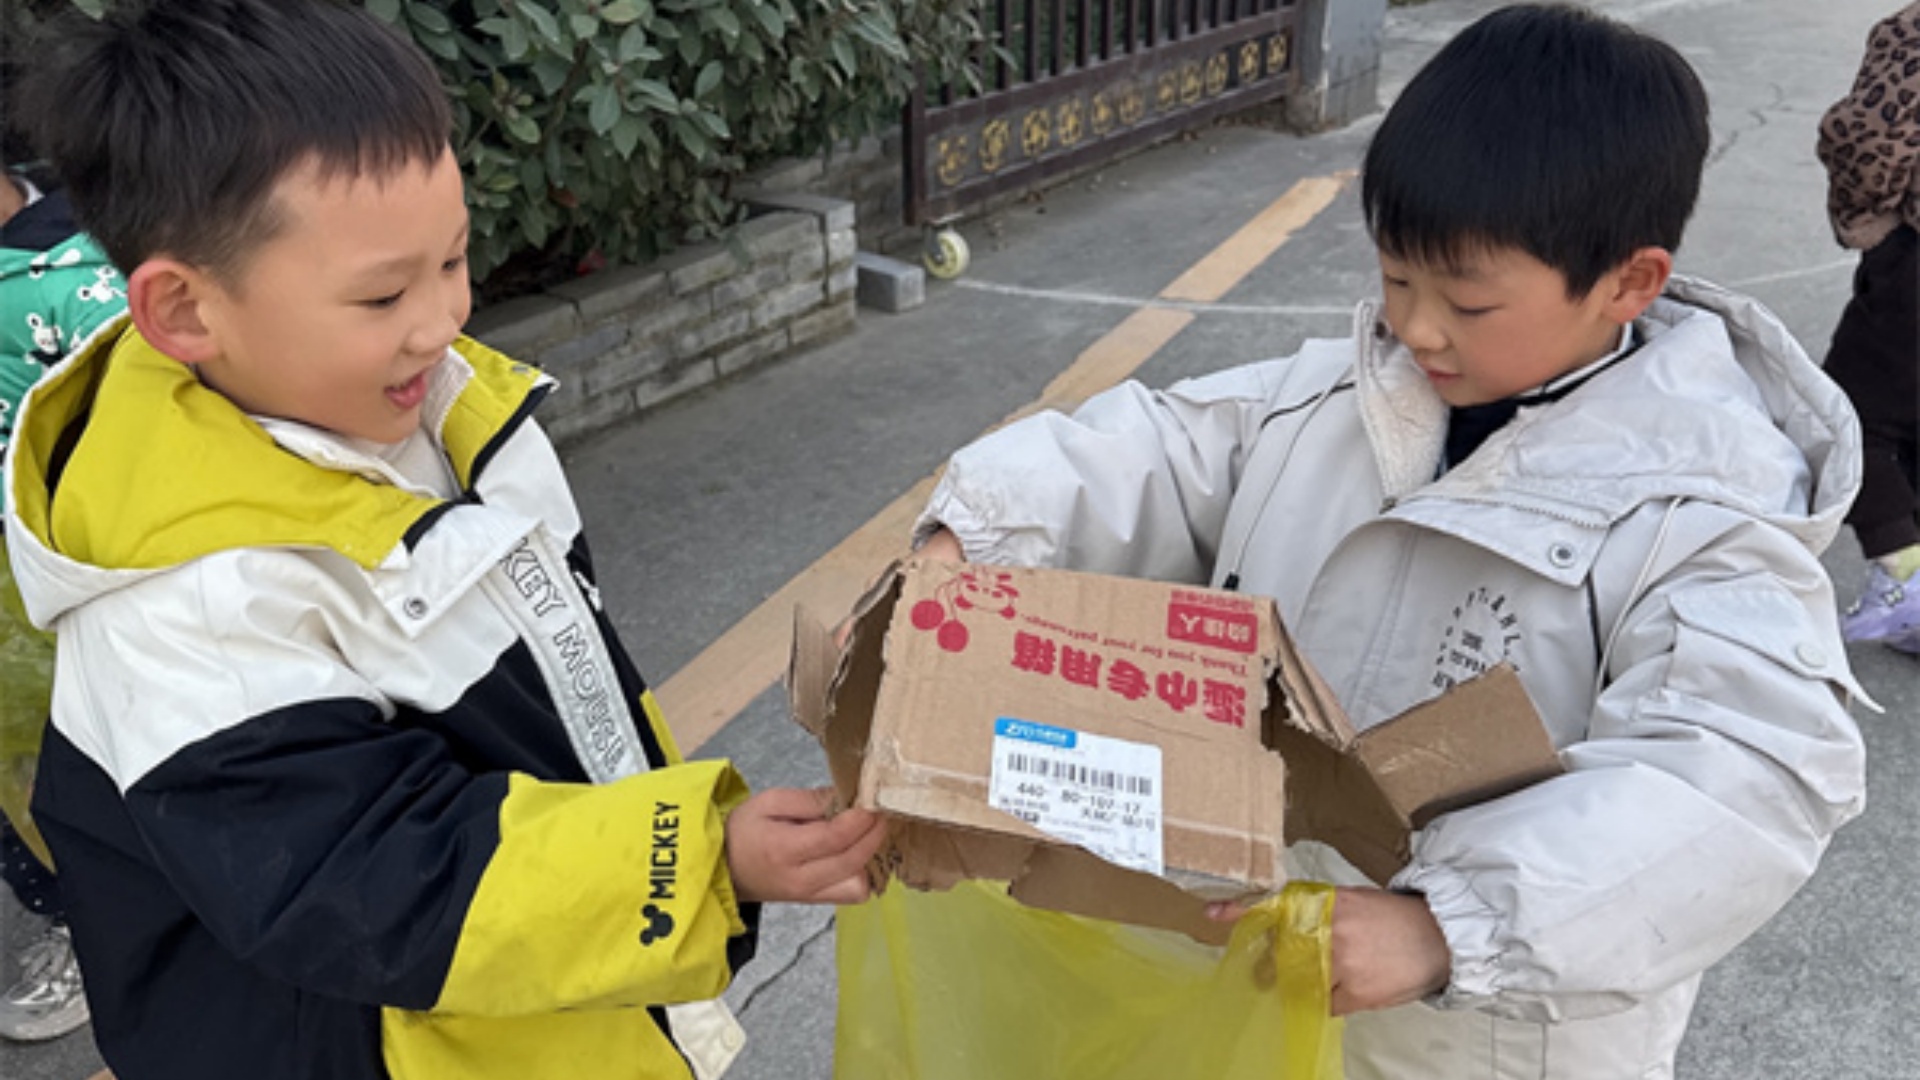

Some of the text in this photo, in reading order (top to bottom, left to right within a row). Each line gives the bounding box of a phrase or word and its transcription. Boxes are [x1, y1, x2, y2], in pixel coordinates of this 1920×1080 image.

[1103, 637, 1136, 652] your
[1141, 644, 1163, 659] for
[1167, 649, 1194, 663] you
[1200, 655, 1248, 677] Thank
[1011, 629, 1246, 729] 湿巾专用箱
[650, 801, 682, 899] MICKEY
